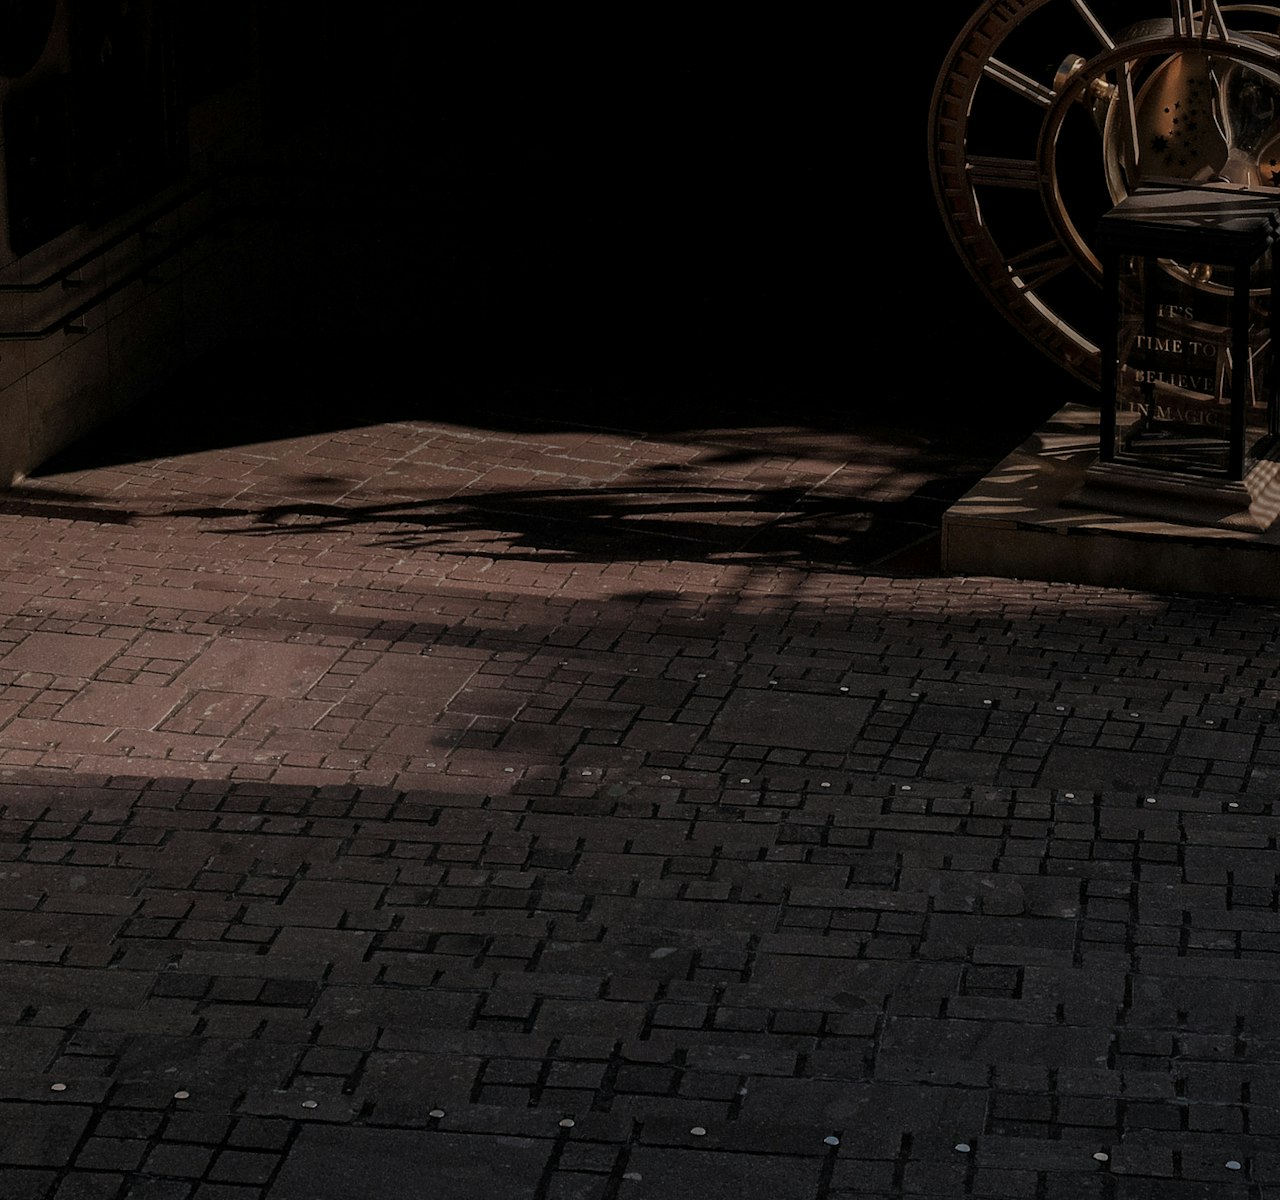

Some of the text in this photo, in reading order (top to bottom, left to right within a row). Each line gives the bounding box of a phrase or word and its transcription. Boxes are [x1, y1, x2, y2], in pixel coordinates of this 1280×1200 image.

[1158, 303, 1194, 320] IT'S
[1136, 335, 1216, 357] TIME TO
[1135, 369, 1215, 391] BELIEVE
[1128, 401, 1218, 425] IN MAGIC
